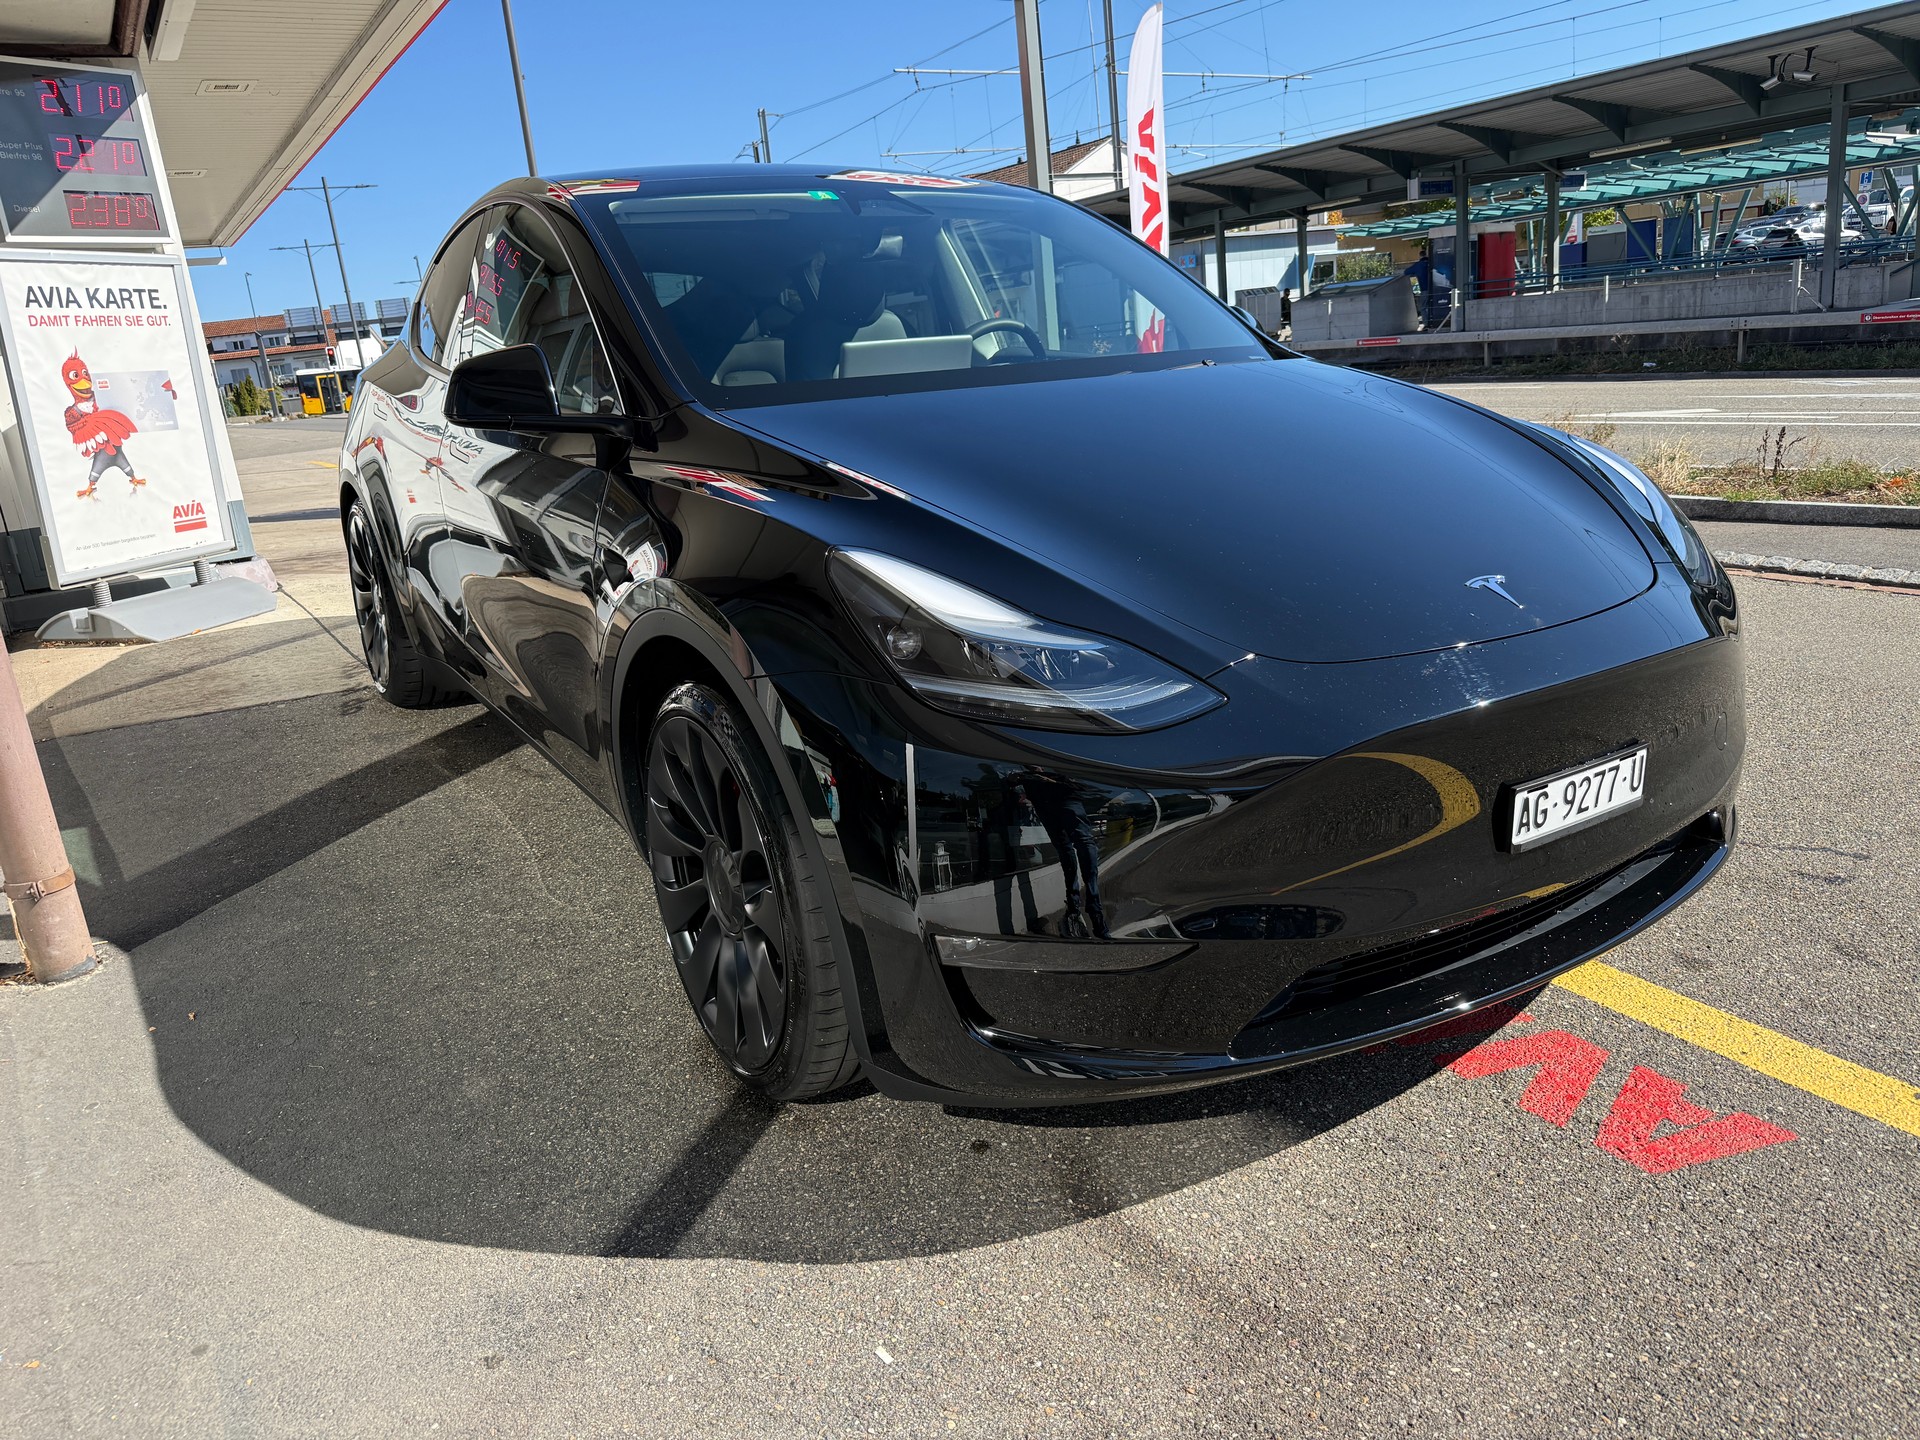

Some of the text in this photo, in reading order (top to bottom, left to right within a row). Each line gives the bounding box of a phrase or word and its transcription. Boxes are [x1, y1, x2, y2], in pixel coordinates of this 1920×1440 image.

[14, 88, 26, 97] 95
[24, 142, 43, 151] Plus
[0, 151, 43, 161] Bleifrei 98
[14, 204, 41, 213] Diesel
[25, 286, 167, 309] AVIA KARTE.
[28, 315, 171, 327] DAMIT FAHREN SIE GUT.
[173, 500, 206, 519] AVIA
